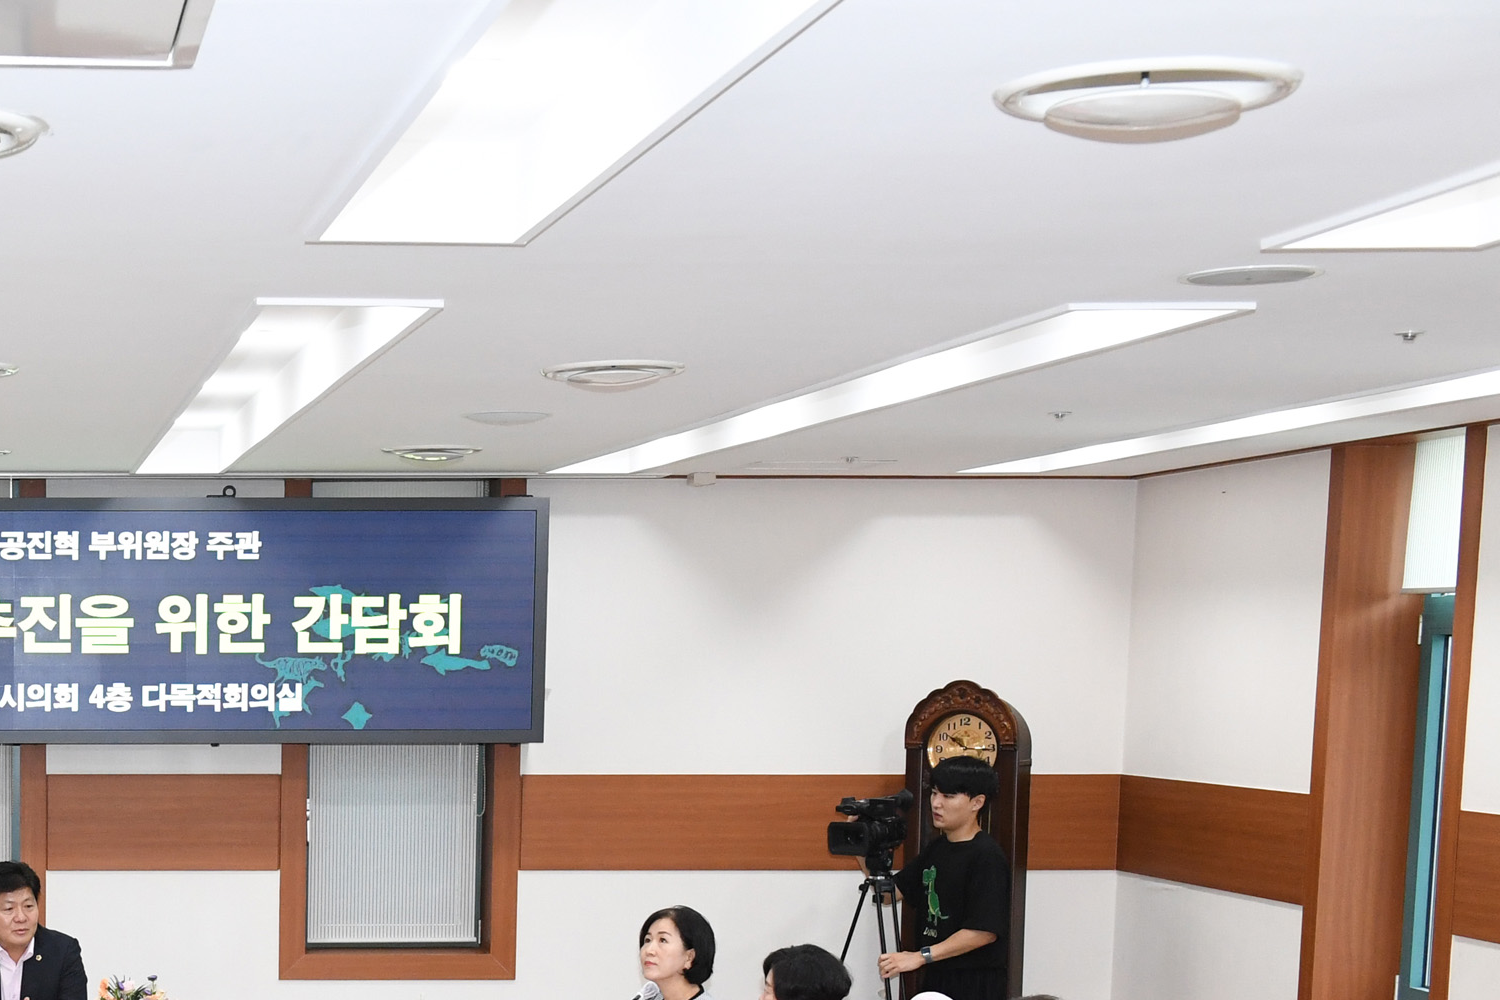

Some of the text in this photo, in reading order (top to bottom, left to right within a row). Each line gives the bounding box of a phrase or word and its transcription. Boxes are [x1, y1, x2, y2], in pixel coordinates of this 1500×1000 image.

[88, 530, 199, 561] 부위원장
[206, 530, 263, 561] 주관
[155, 593, 271, 655] 위한
[291, 593, 462, 655] 간담회
[88, 682, 134, 713] 4층
[141, 682, 303, 713] 다목적회의실
[947, 722, 956, 730] 11
[960, 717, 971, 726] 12
[939, 732, 948, 741] 10
[985, 731, 992, 739] 2
[936, 745, 943, 753] 9
[988, 744, 996, 752] 3
